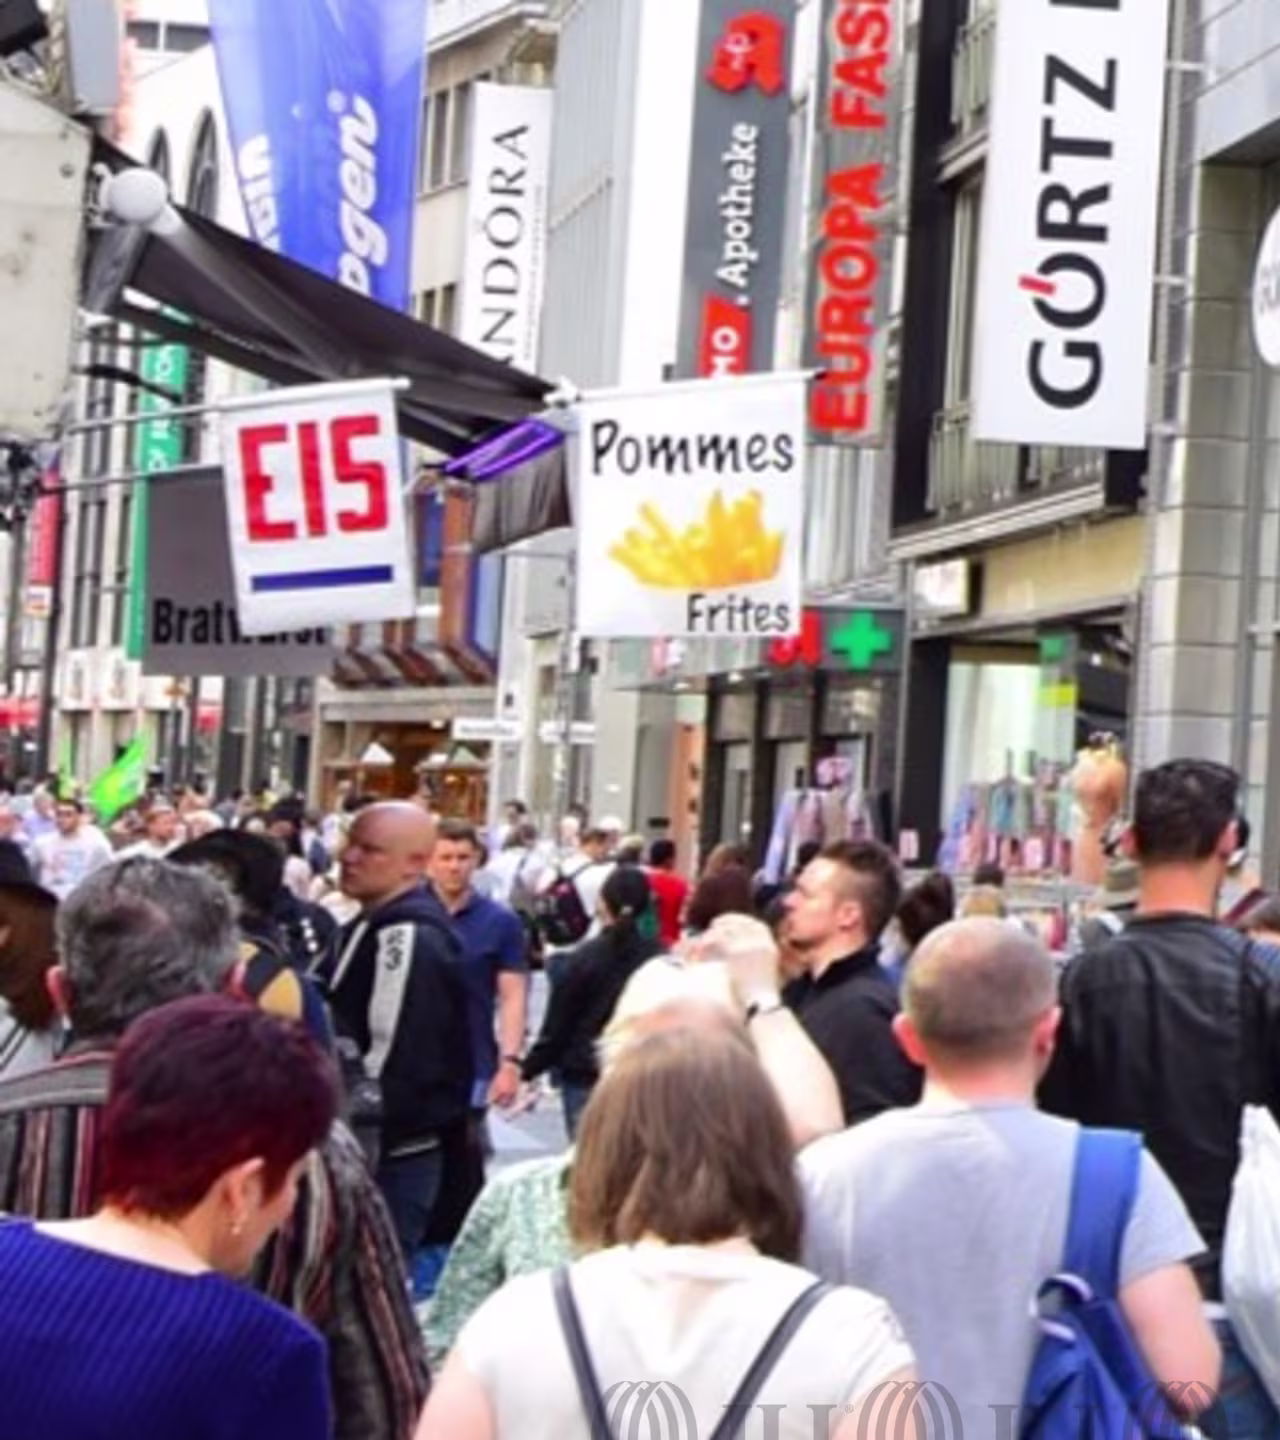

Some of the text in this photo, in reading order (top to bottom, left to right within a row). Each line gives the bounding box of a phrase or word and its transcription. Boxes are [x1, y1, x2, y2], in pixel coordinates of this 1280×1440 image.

[480, 124, 530, 366] NDORA
[809, 0, 893, 433] EUROPA FAS
[238, 413, 389, 543] EIS
[591, 418, 795, 476] Pommes
[686, 593, 791, 633] Frites
